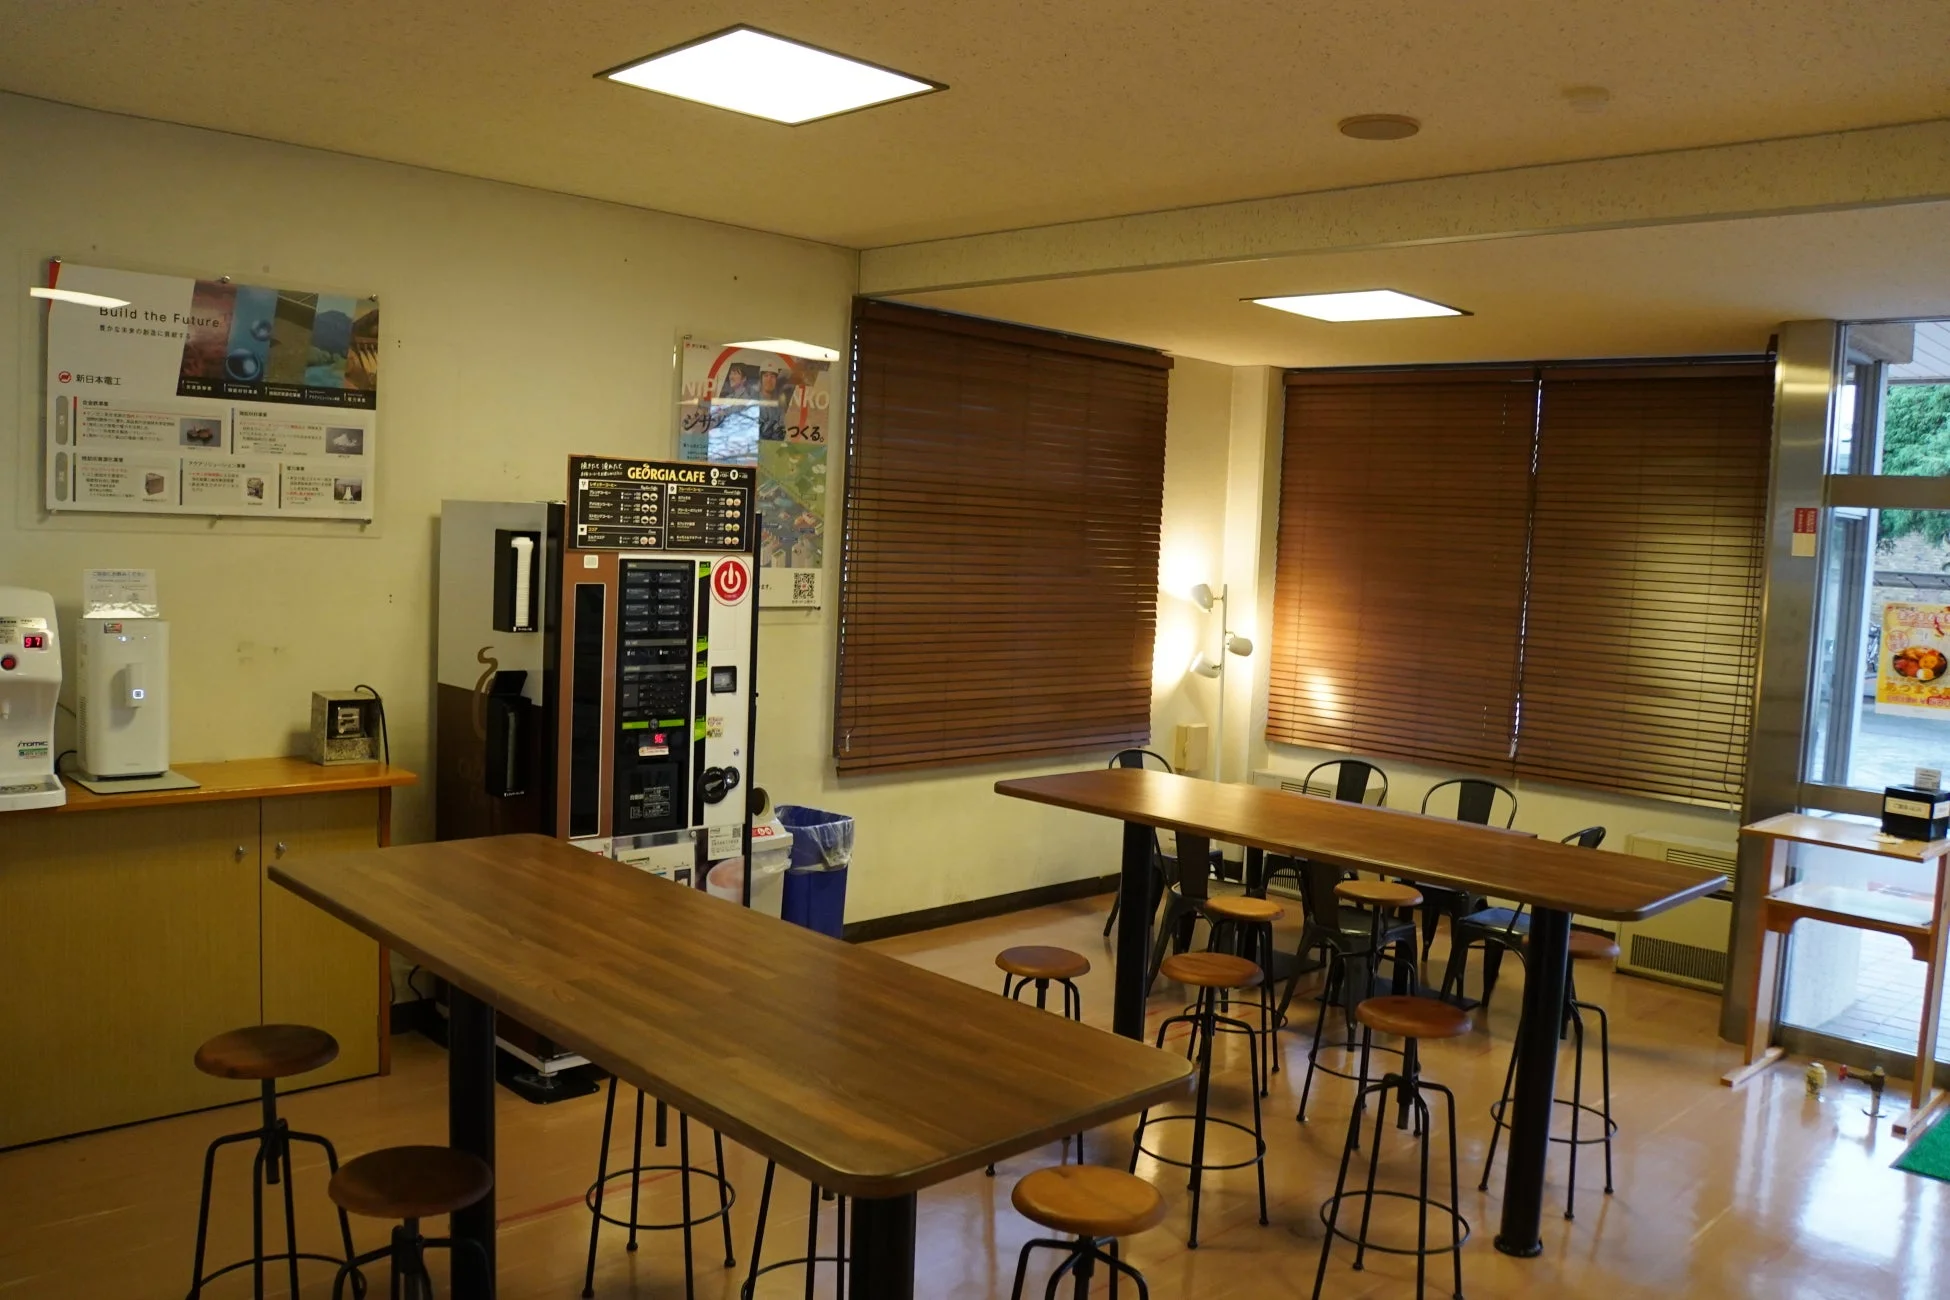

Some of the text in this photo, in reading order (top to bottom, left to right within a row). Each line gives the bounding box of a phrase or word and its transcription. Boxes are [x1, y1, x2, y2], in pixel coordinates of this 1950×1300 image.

[99, 306, 220, 328] Build the Future
[75, 373, 122, 386] 新日本電工
[627, 463, 676, 482] GEORGIA
[678, 469, 706, 484] CAFE
[25, 637, 41, 648] 97
